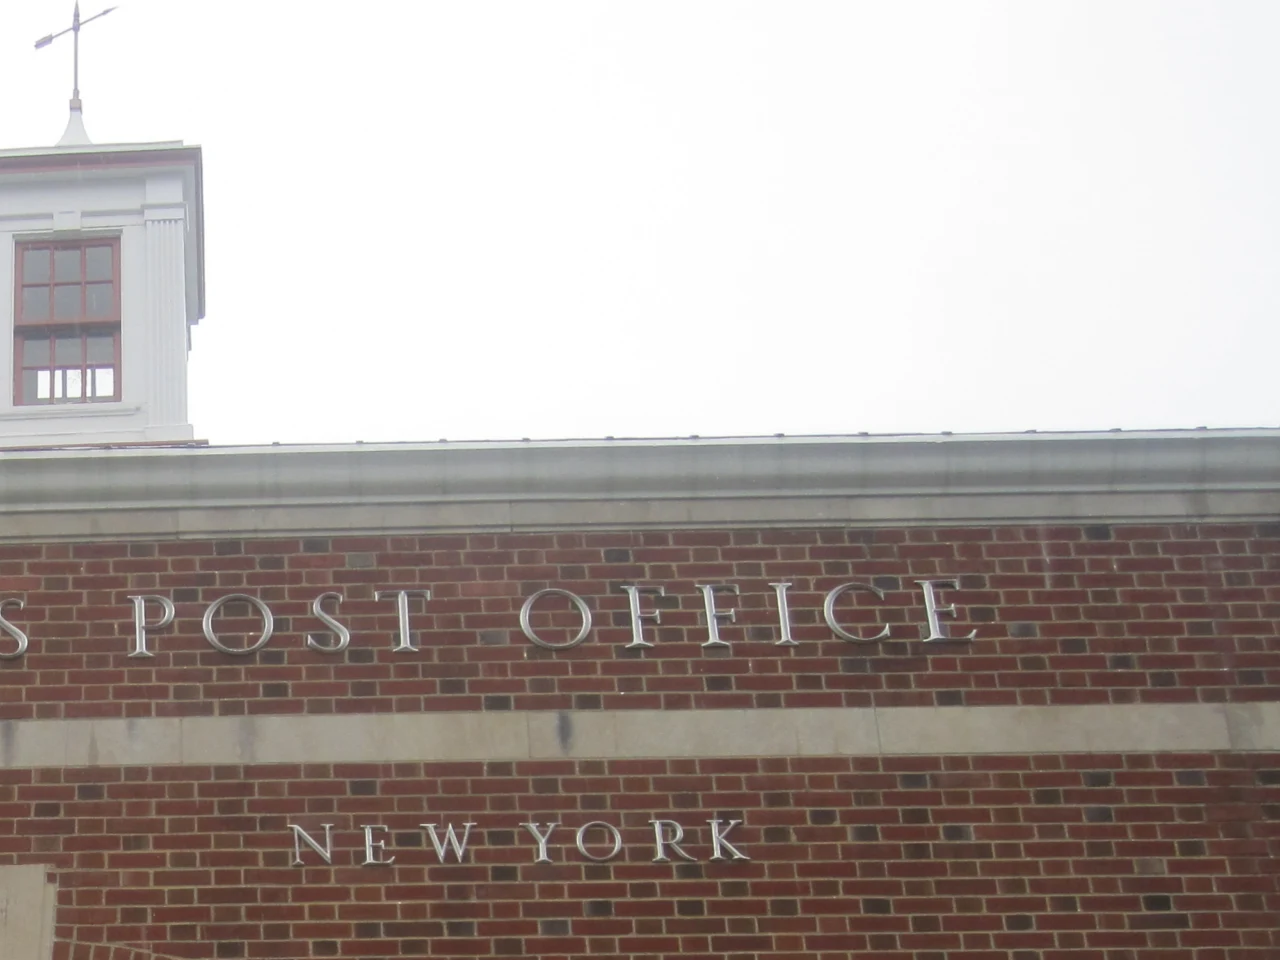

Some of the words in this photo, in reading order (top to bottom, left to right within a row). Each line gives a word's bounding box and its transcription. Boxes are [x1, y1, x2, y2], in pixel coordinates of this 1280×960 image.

[126, 588, 431, 658] POST
[518, 578, 978, 651] OFFICE
[287, 821, 478, 866] NEW
[519, 818, 752, 864] YORK
